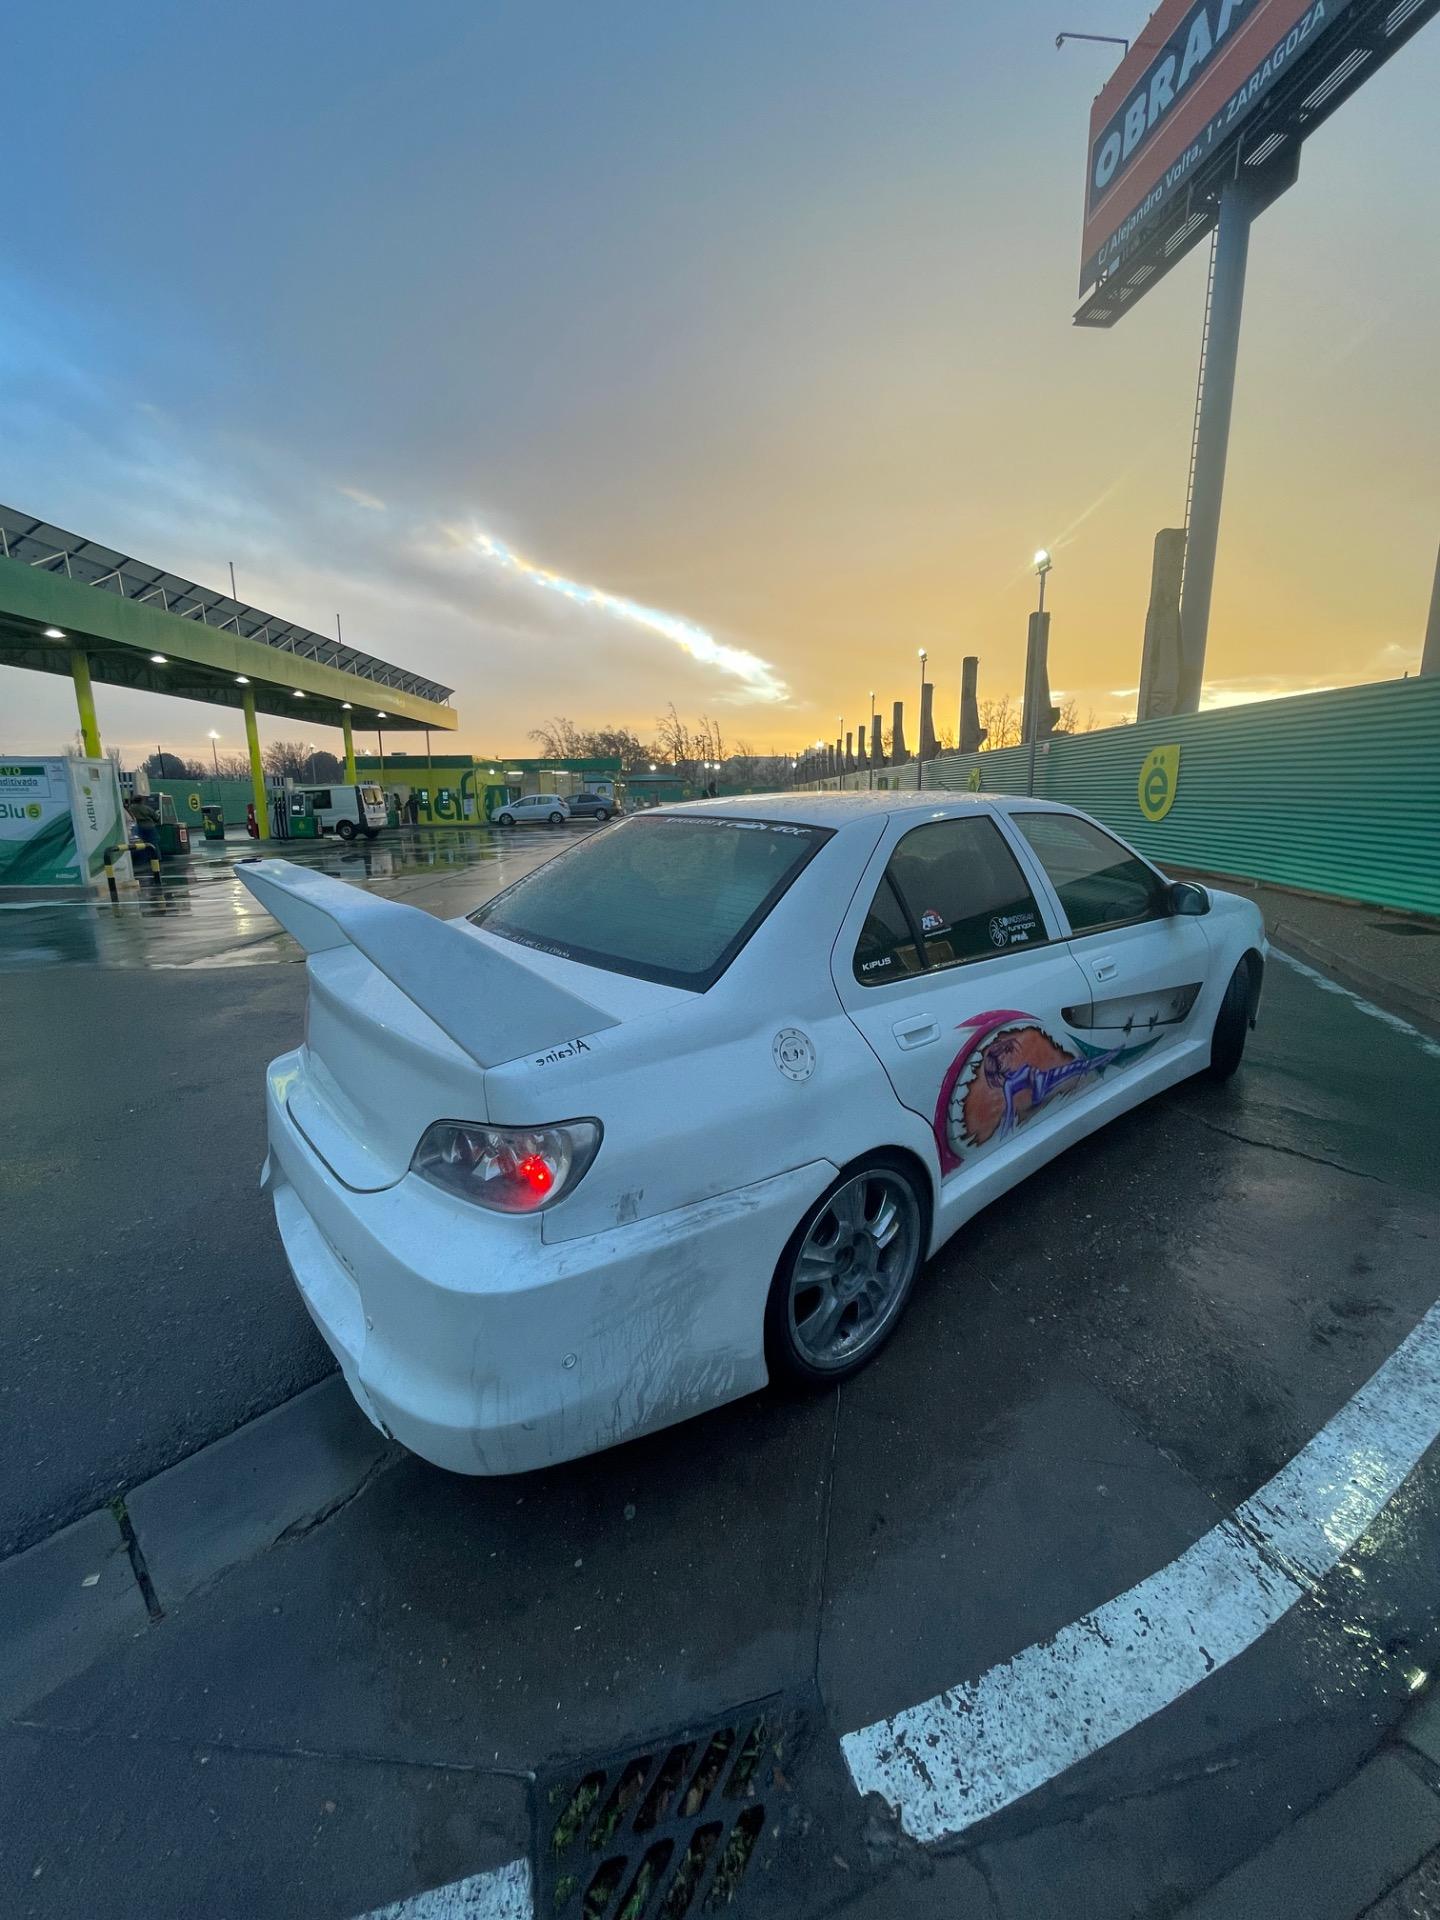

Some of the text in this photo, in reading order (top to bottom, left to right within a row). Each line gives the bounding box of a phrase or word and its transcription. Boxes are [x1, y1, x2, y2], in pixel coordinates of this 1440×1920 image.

[1095, 0, 1243, 188] OBRA
[1110, 185, 1163, 253] Alejandro
[1226, 1, 1326, 122] ZARAGOZA
